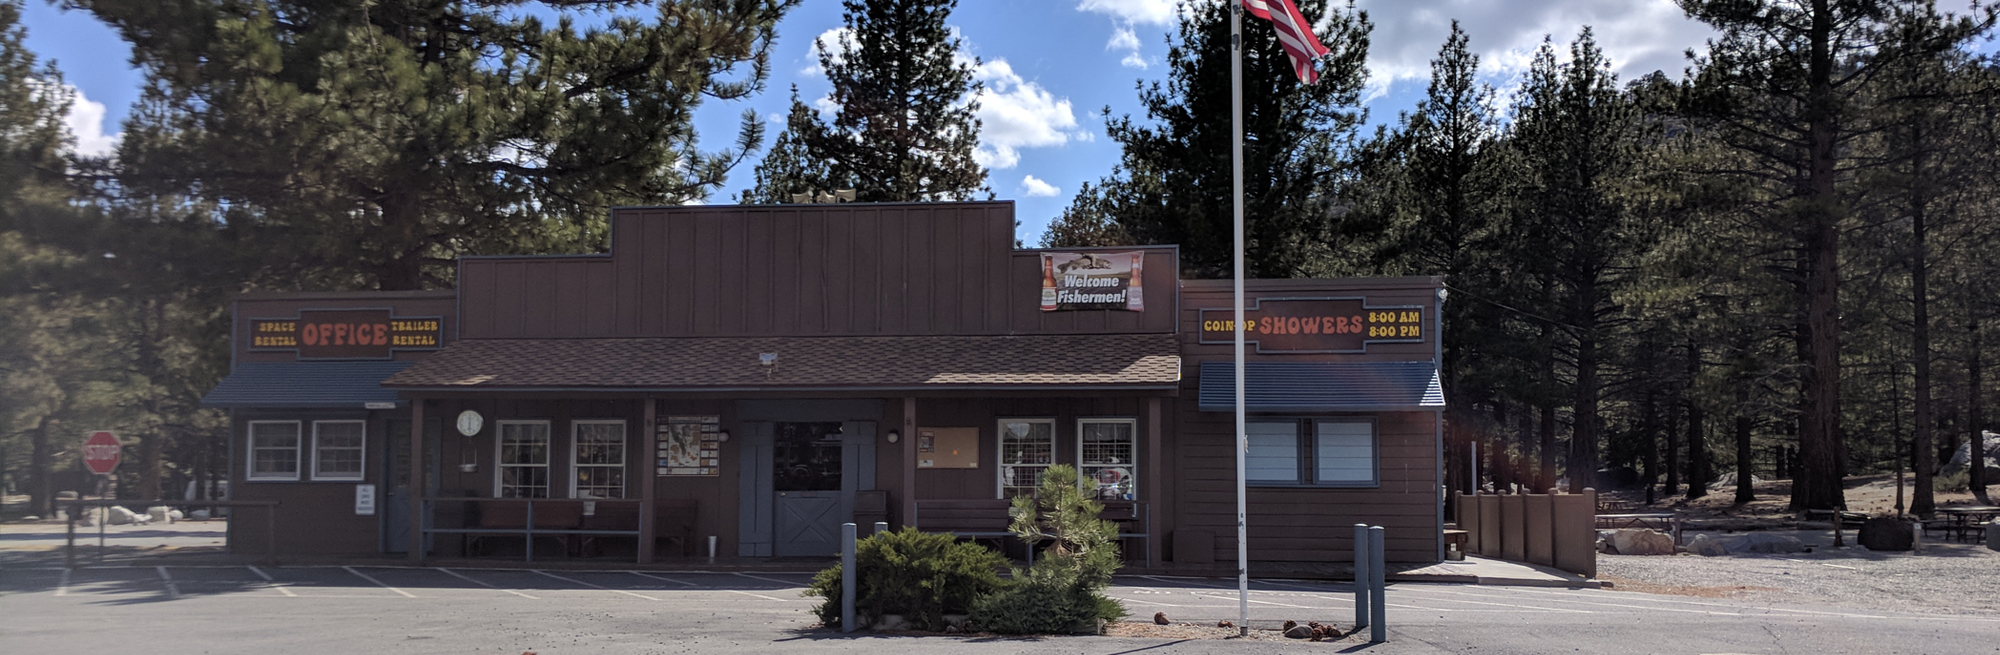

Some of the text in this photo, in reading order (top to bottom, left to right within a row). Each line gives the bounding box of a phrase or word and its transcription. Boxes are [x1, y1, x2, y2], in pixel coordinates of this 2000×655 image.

[1064, 274, 1119, 288] Welcome
[1057, 289, 1127, 304] Fishermen!
[1368, 311, 1420, 324] 8:00 AM
[258, 322, 296, 332] SPACE
[391, 321, 438, 332] TRAILER
[1259, 315, 1363, 335] SHOWERS
[1368, 325, 1420, 338] 8:00 PM
[302, 322, 389, 347] OFFICE
[392, 335, 436, 346] RENTAL
[254, 336, 298, 347] RENTAL
[84, 444, 120, 460] STOP
